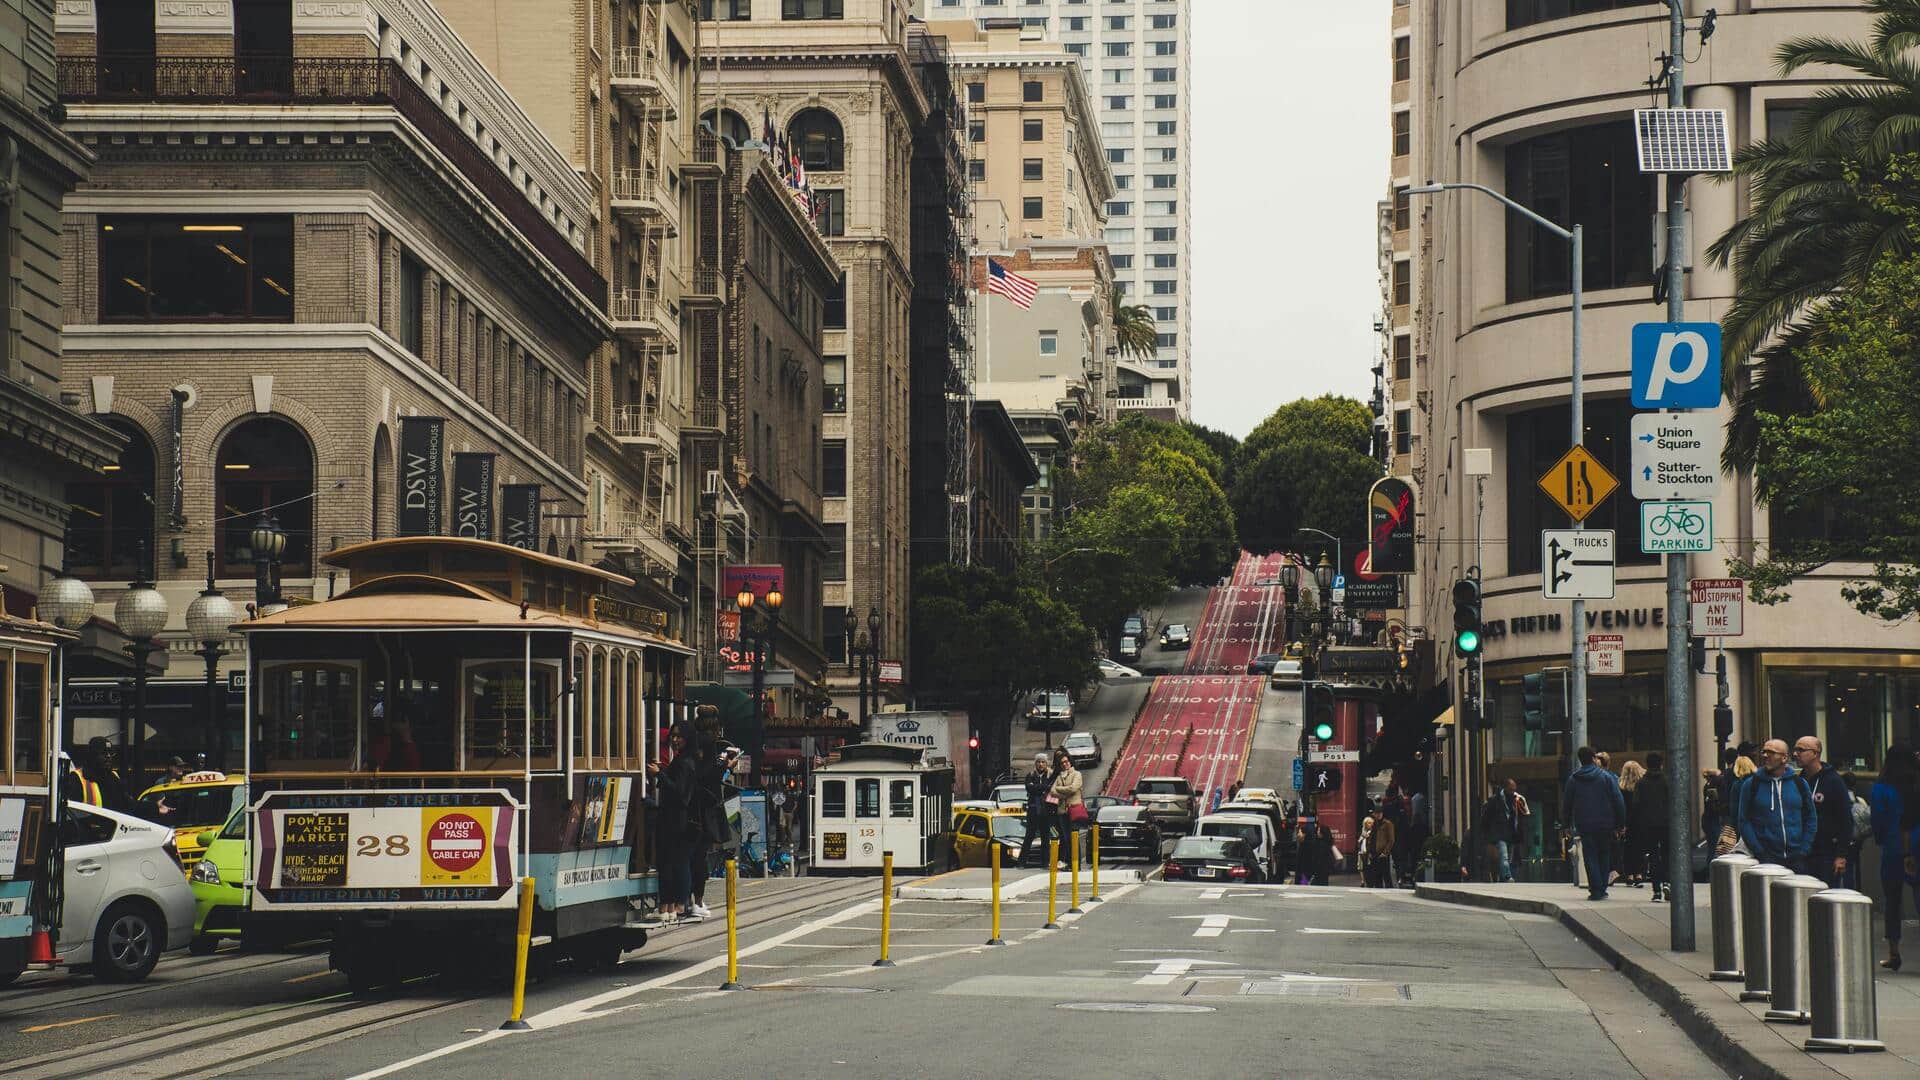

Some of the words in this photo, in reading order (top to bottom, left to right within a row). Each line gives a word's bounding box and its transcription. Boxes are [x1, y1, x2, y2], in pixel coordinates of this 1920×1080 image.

[1657, 427, 1693, 438] Union
[429, 424, 439, 473] WAREHOUSE
[1657, 439, 1701, 451] Square
[1657, 462, 1701, 473] Sutter-
[406, 452, 427, 510] DSW
[480, 460, 490, 506] WAREHOUSE
[1657, 473, 1713, 485] Stockton
[428, 475, 437, 498] SHOE
[458, 487, 479, 539] DSW
[479, 506, 488, 530] SHOE
[507, 517, 526, 550] SW
[1573, 537, 1609, 548] TRUCKS
[1651, 538, 1704, 550] PARKING
[1694, 580, 1739, 588] TOW-AWAY
[1692, 589, 1706, 602] NO
[1707, 591, 1742, 603] STOPPING
[1707, 604, 1727, 615] ANY
[1511, 614, 1561, 634] FIFTH
[1585, 607, 1665, 628] VENUE
[1706, 615, 1729, 626] TIME
[1588, 642, 1598, 651] NO
[1599, 652, 1613, 660] ANY
[1599, 659, 1614, 667] TIME
[1194, 728, 1247, 736] ONLY
[883, 732, 935, 746] Corona
[1190, 753, 1238, 761] MUNI
[189, 773, 218, 783] TAXI
[288, 795, 367, 808] MARKET
[386, 794, 464, 806] STREET
[288, 816, 347, 826] POWELL
[439, 821, 453, 830] DO
[454, 821, 475, 830] NOT
[303, 825, 332, 833] AND
[444, 830, 469, 838] PASS
[859, 828, 875, 837] 12
[286, 833, 347, 842] MARKET
[356, 835, 410, 857] 28
[285, 855, 306, 865] HYDE
[318, 855, 345, 865] BEACH
[433, 851, 460, 859] CABLE
[462, 851, 480, 859] CAR
[300, 874, 327, 882] WHARF
[279, 888, 401, 901] FISHERMANS
[422, 887, 489, 899] WHARF
